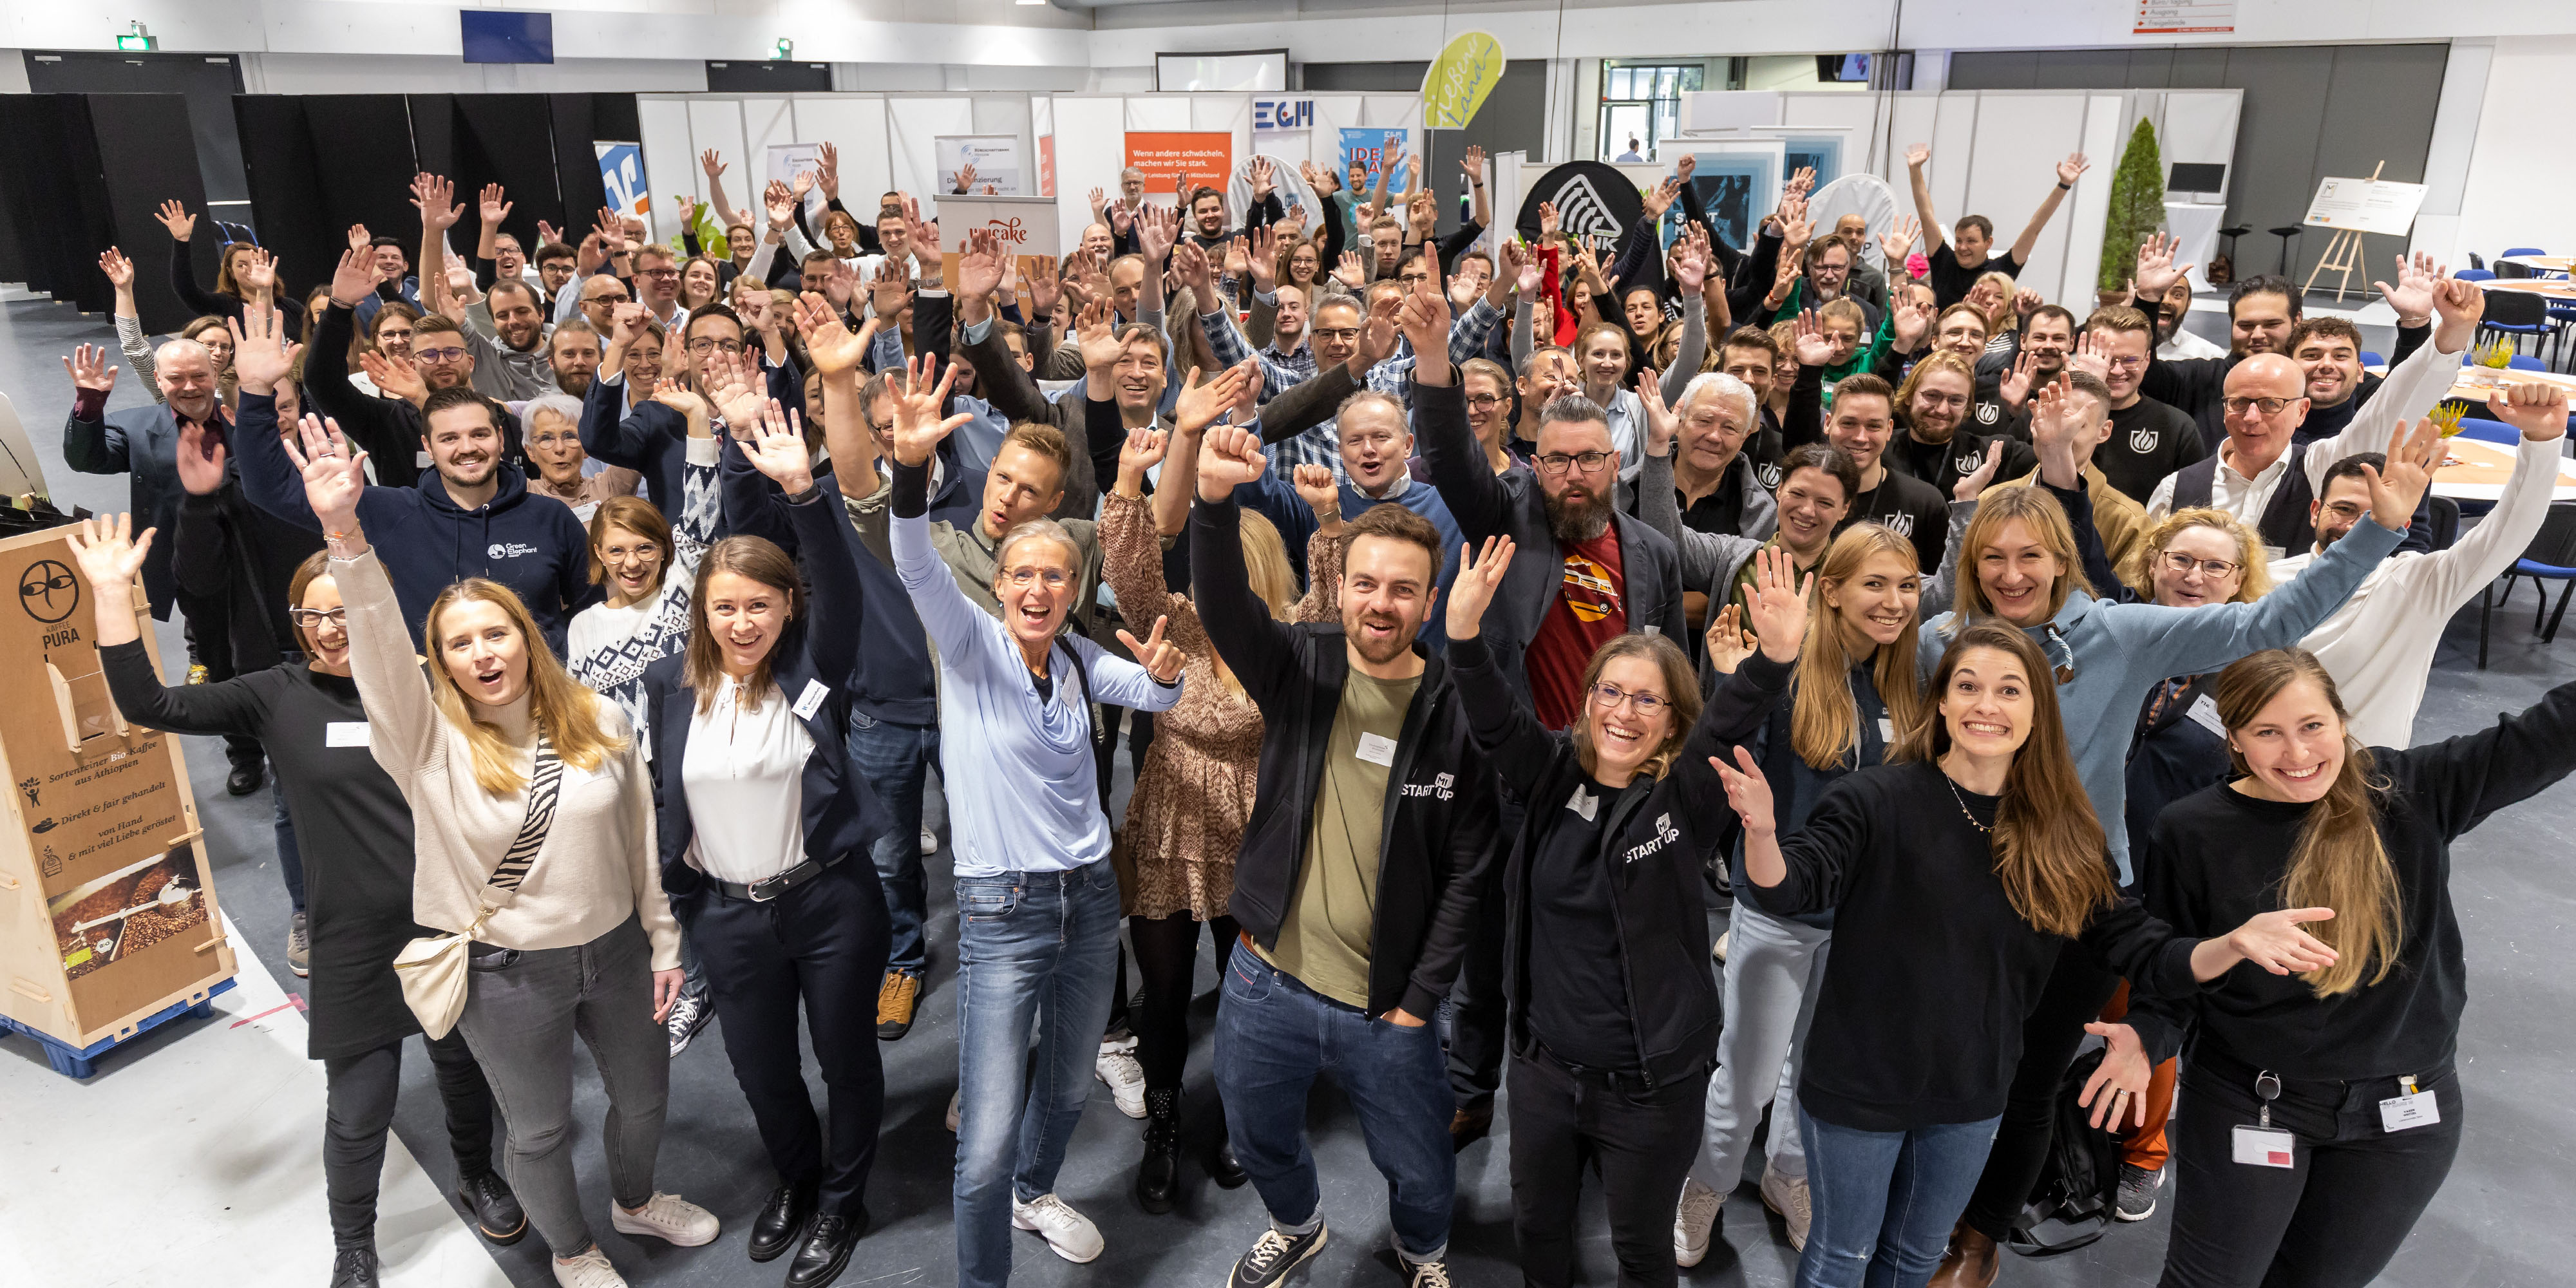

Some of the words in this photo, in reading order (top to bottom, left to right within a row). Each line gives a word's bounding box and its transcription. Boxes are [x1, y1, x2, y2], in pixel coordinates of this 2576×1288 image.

[1446, 41, 1493, 127] Land
[1182, 149, 1225, 158] schwächeln,
[1350, 147, 1384, 161] IDE
[507, 547, 537, 555] Elephant
[46, 621, 71, 633] KAFFEE
[42, 628, 80, 650] PURA
[49, 756, 108, 783] Sortenreiner
[110, 741, 158, 762] Bio-Kaffee
[75, 775, 91, 786] aus
[93, 759, 139, 780] Äthiopien
[1437, 775, 1448, 786] MI
[1401, 784, 1435, 797] START
[1436, 787, 1454, 801] UP
[61, 808, 91, 825] Direkt
[93, 804, 101, 813] &
[101, 798, 120, 813] fair
[122, 781, 166, 805] gehandelt
[97, 827, 116, 837] von
[117, 815, 144, 831] Hand
[1658, 820, 1667, 833] MI
[68, 852, 76, 861] &
[78, 845, 95, 858] mit
[97, 837, 114, 849] viel
[115, 828, 140, 843] Liebe
[142, 815, 176, 835] geröstet
[1663, 828, 1680, 844] UP
[1622, 836, 1662, 864] START
